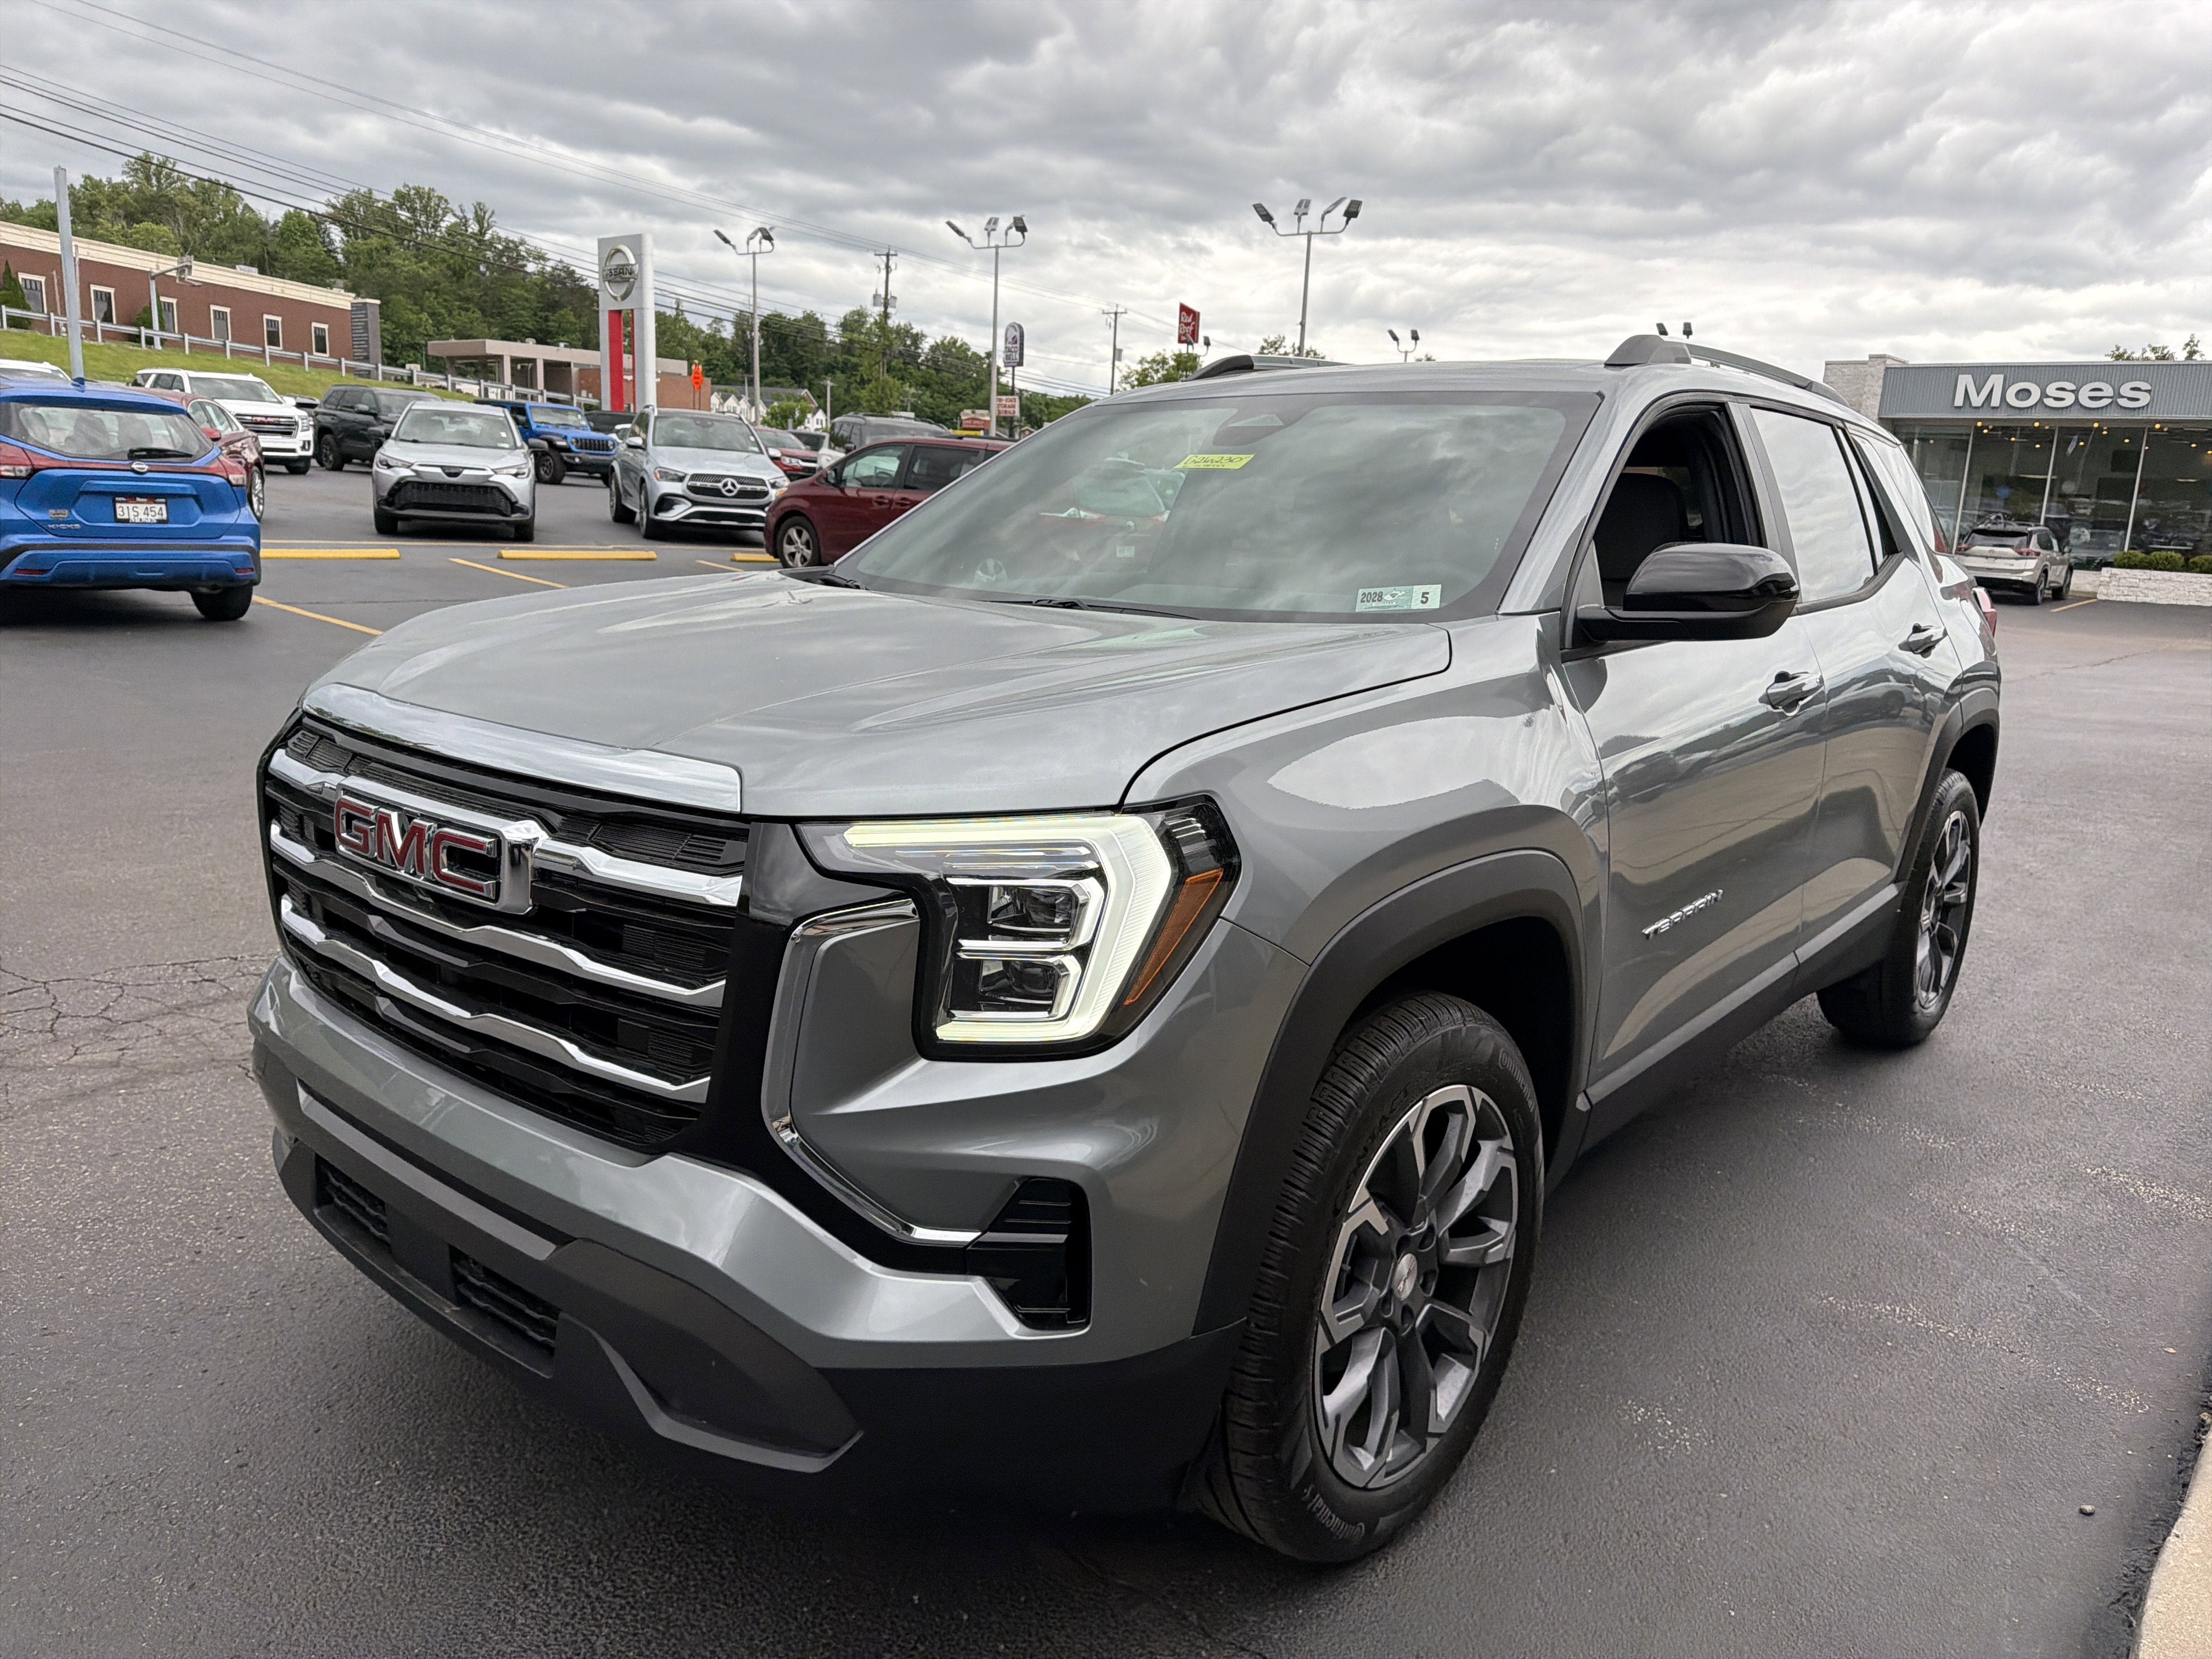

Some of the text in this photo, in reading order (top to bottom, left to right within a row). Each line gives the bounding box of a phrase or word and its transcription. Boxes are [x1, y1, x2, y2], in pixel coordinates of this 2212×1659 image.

[1181, 311, 1193, 323] Red
[1954, 374, 2152, 408] Moses
[118, 506, 163, 517] 31S 454
[1360, 591, 1430, 605] 2028 5
[334, 795, 496, 899] GMC
[1642, 889, 1723, 940] TERRAIN
